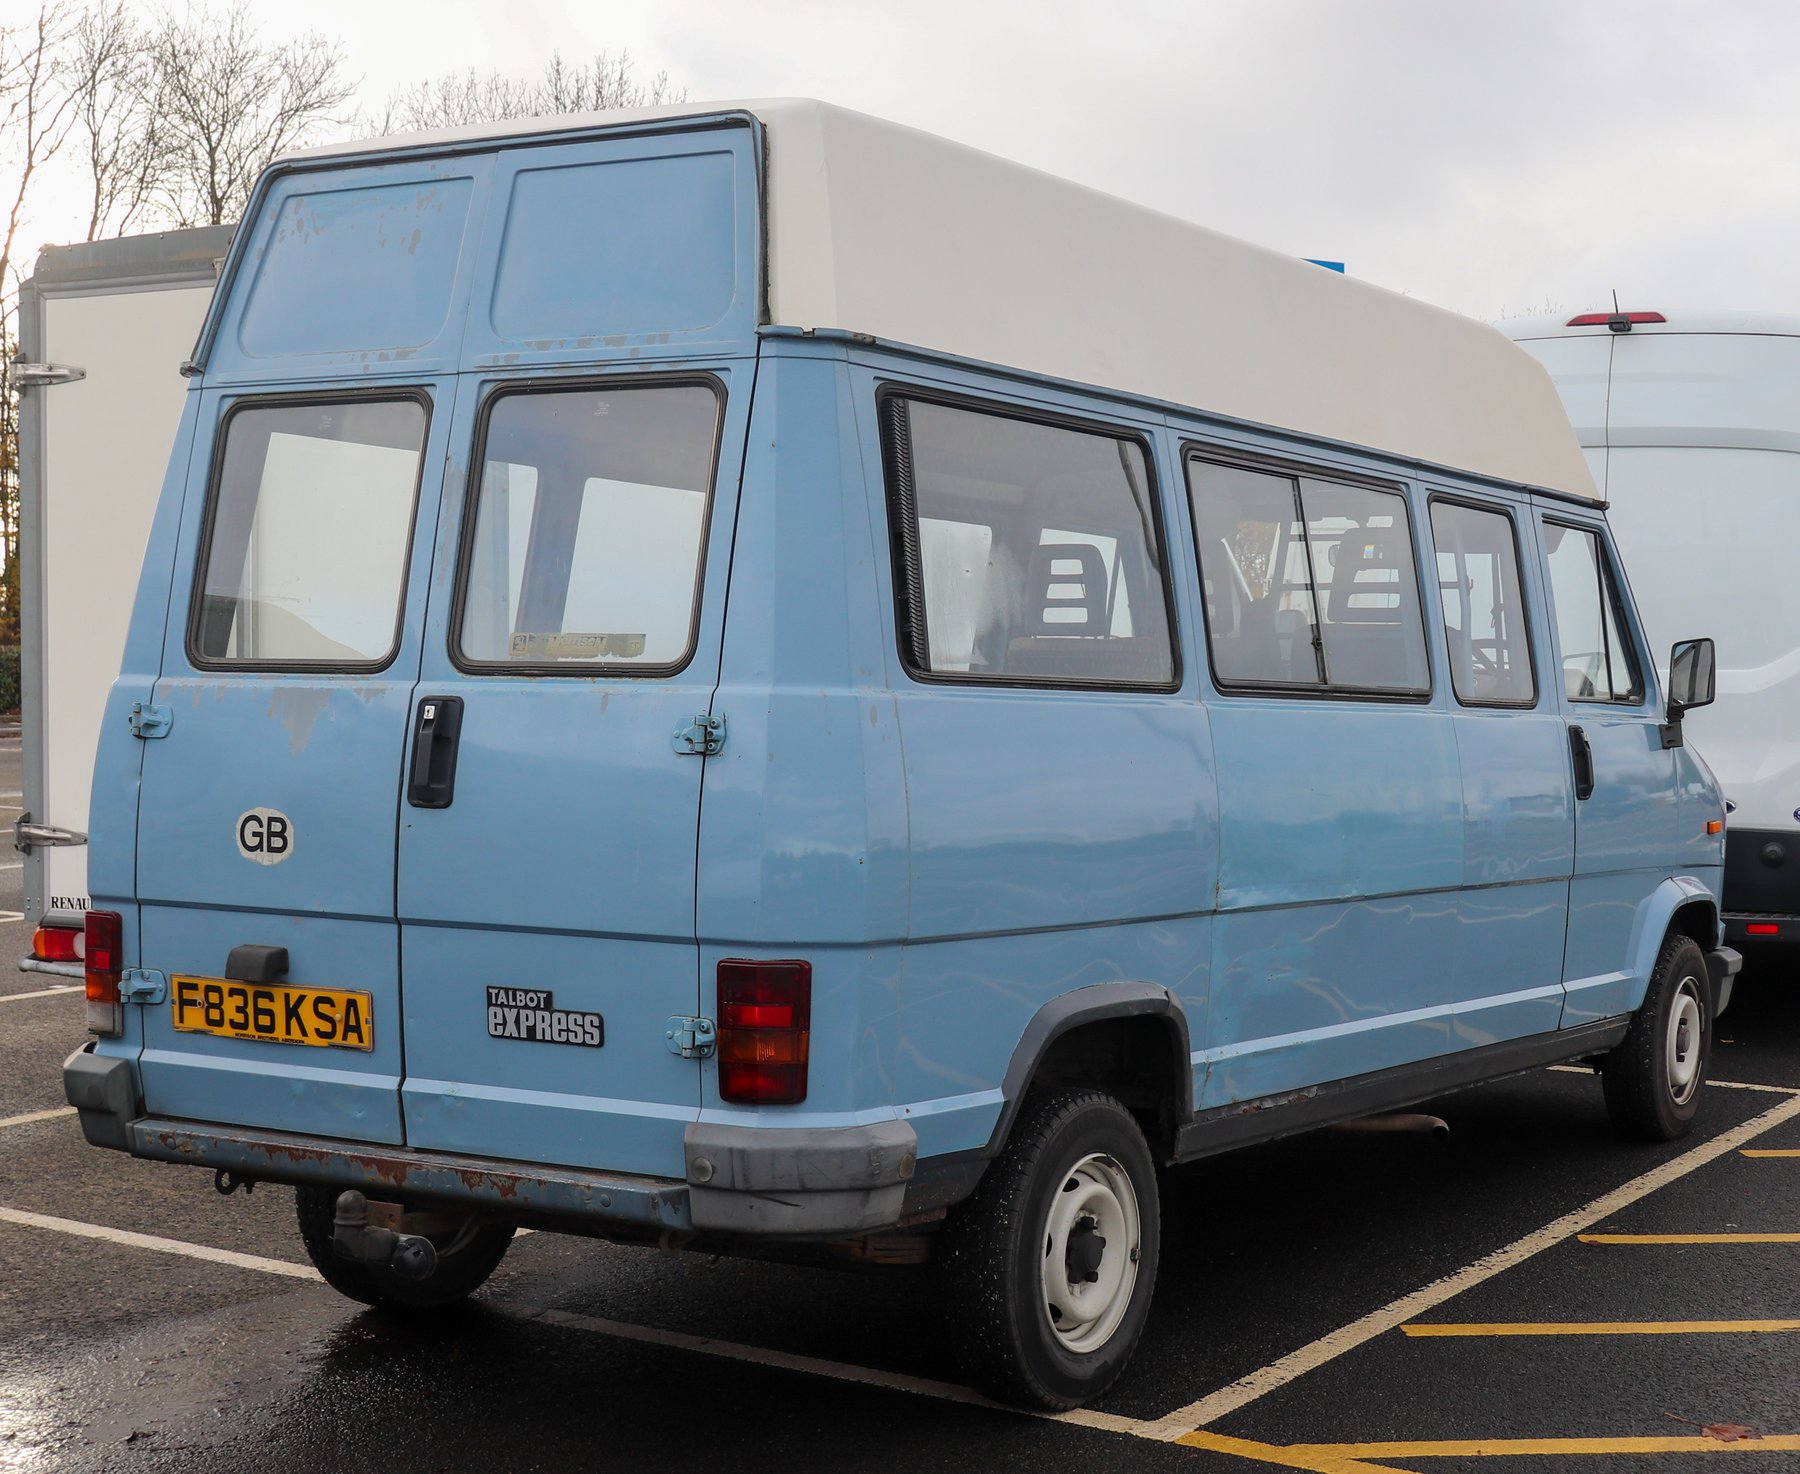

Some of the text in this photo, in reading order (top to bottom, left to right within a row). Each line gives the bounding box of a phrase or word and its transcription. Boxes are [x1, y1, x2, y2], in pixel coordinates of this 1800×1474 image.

[240, 814, 288, 854] GB
[51, 896, 93, 910] RENAU
[488, 988, 547, 1008] TALBOT
